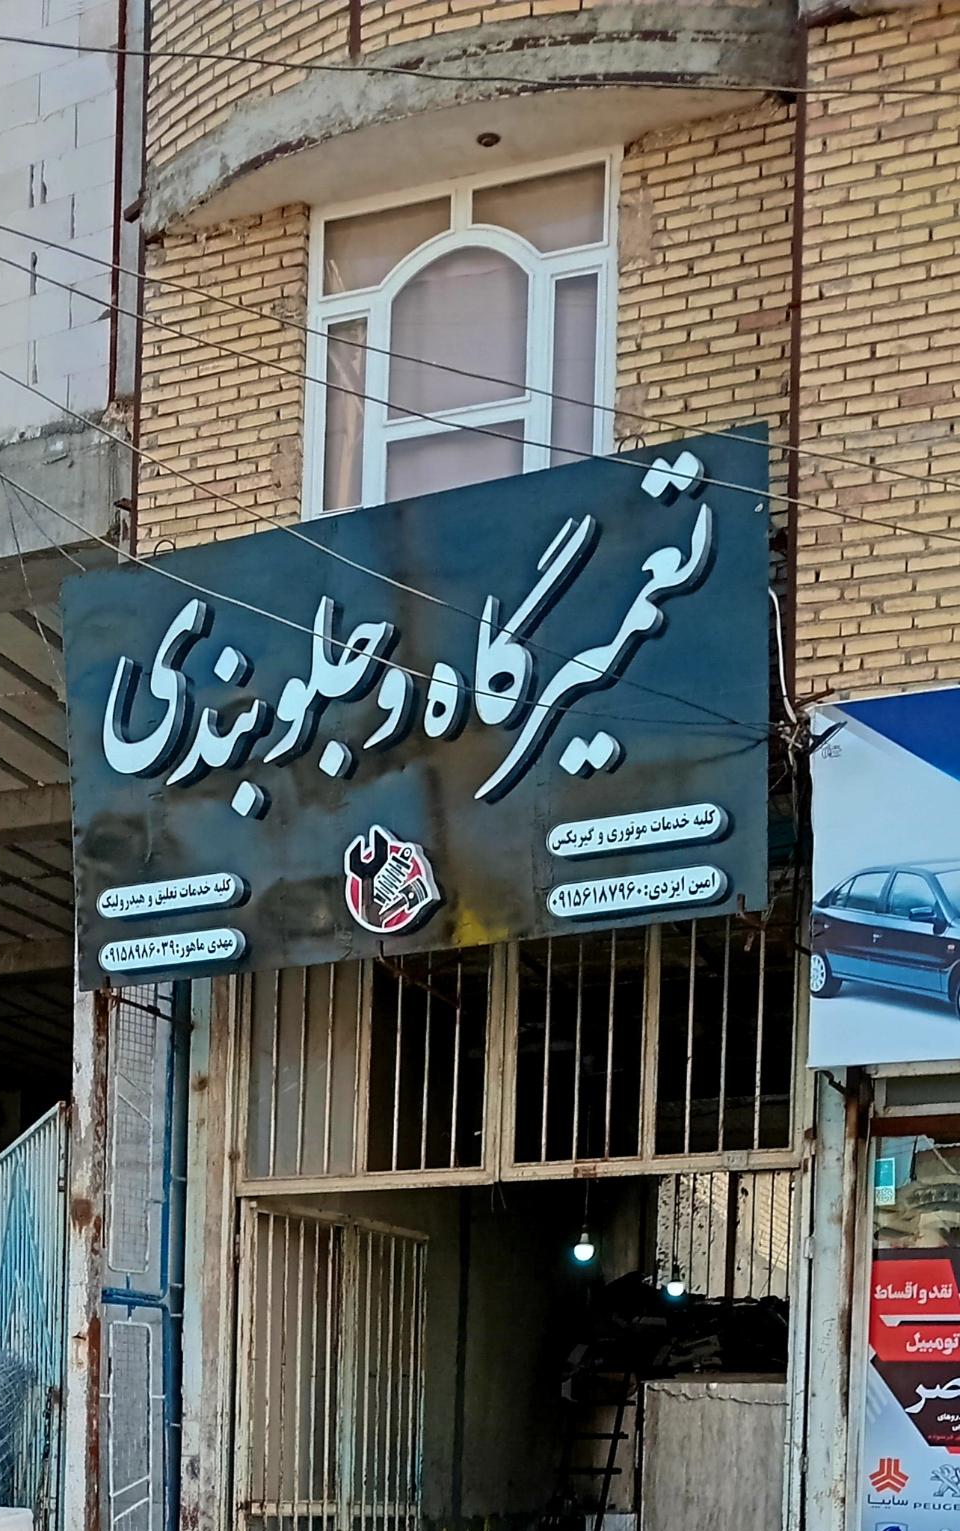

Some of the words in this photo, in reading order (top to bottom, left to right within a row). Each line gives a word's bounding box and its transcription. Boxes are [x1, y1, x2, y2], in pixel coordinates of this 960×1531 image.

[424, 450, 713, 800] تعمیرگاه
[363, 665, 414, 750] و
[650, 812, 690, 832] خدمات
[693, 808, 716, 830] کلیه
[551, 826, 595, 850] گیربکس
[597, 831, 604, 845] و
[606, 819, 648, 844] موتوری
[179, 880, 211, 899] خدمات
[213, 877, 232, 897] کلیه
[687, 871, 716, 896] امین
[100, 893, 146, 912] هیدرولیک
[147, 894, 153, 907] و
[155, 886, 178, 906] تعلیق
[206, 938, 234, 955] مهدی
[873, 1280, 918, 1300] اقساط
[917, 1288, 928, 1305] و
[928, 1283, 953, 1299] نقد
[905, 1331, 960, 1355] تومبیل
[913, 1501, 960, 1511] PEUGE
